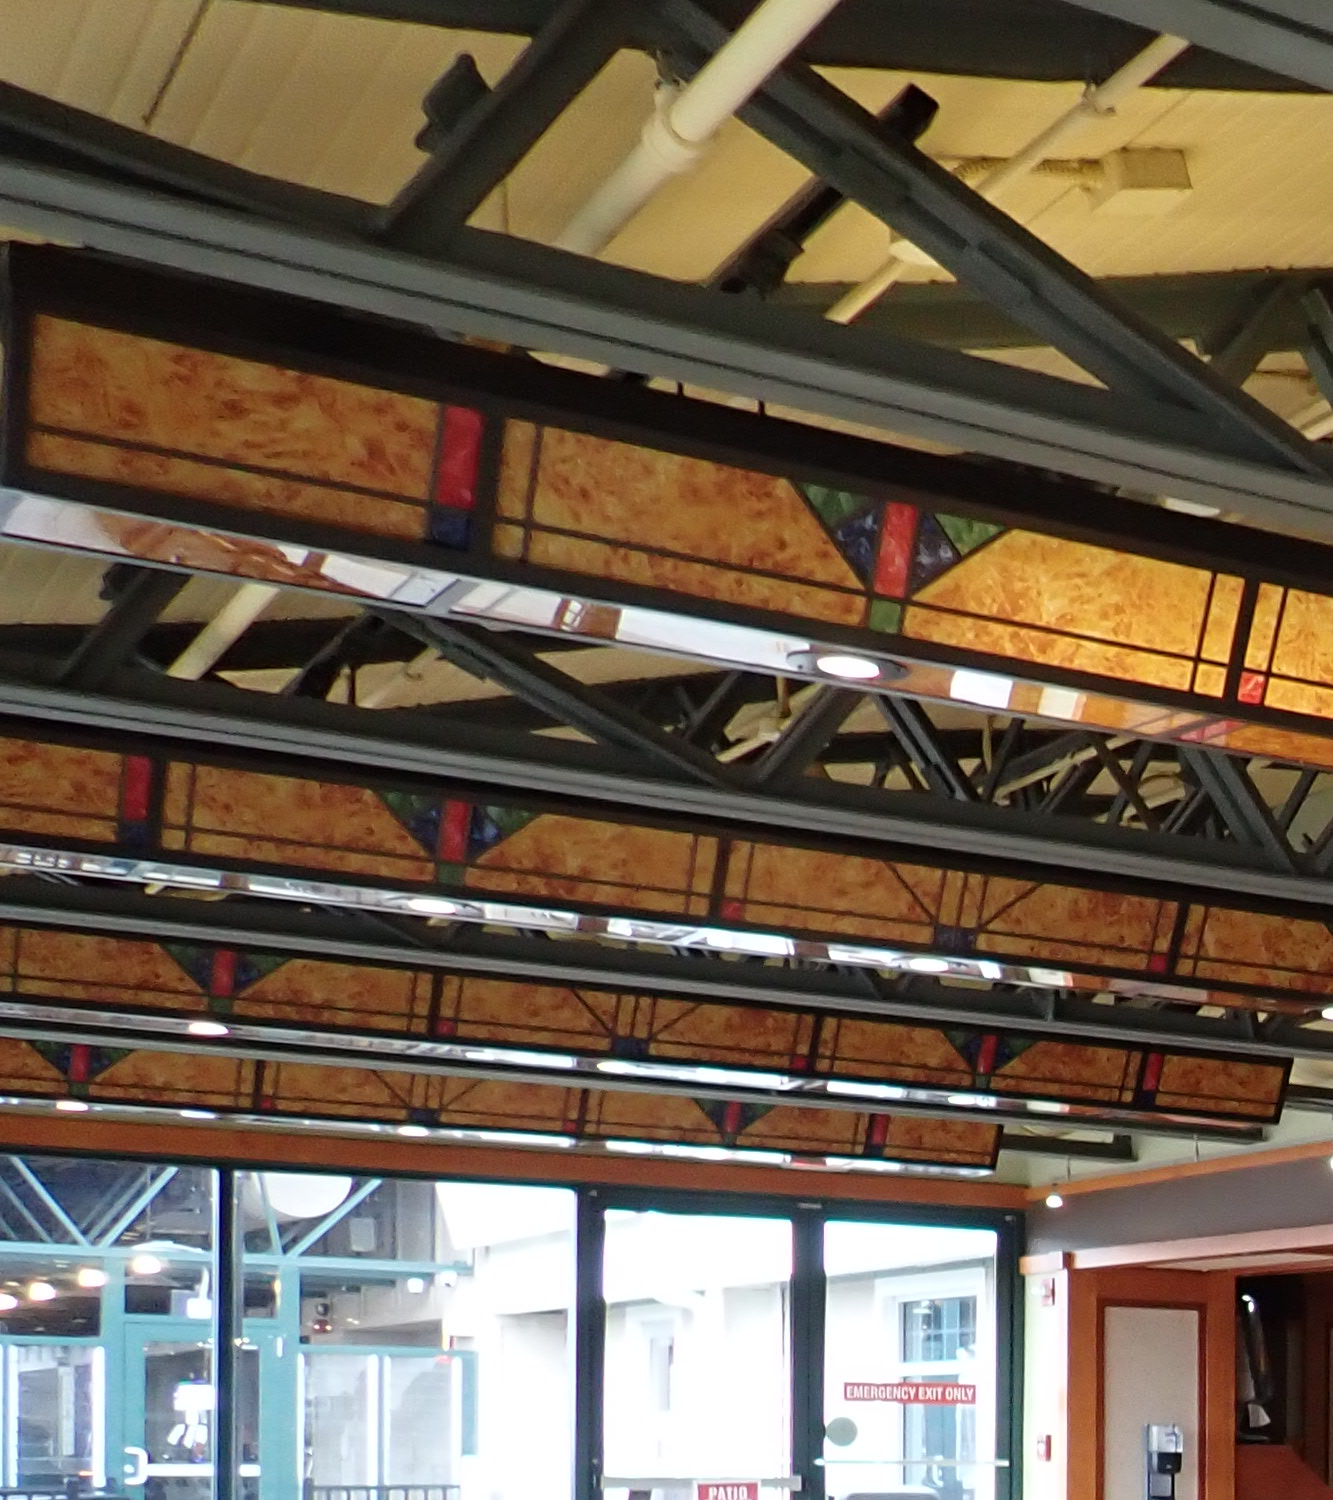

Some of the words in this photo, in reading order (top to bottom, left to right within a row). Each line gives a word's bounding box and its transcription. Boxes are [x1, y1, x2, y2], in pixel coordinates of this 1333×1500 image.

[846, 1385, 916, 1400] EMERGENCY
[918, 1386, 943, 1401] EXIT
[945, 1386, 974, 1401] ONLY
[708, 1485, 748, 1500] PATIO
